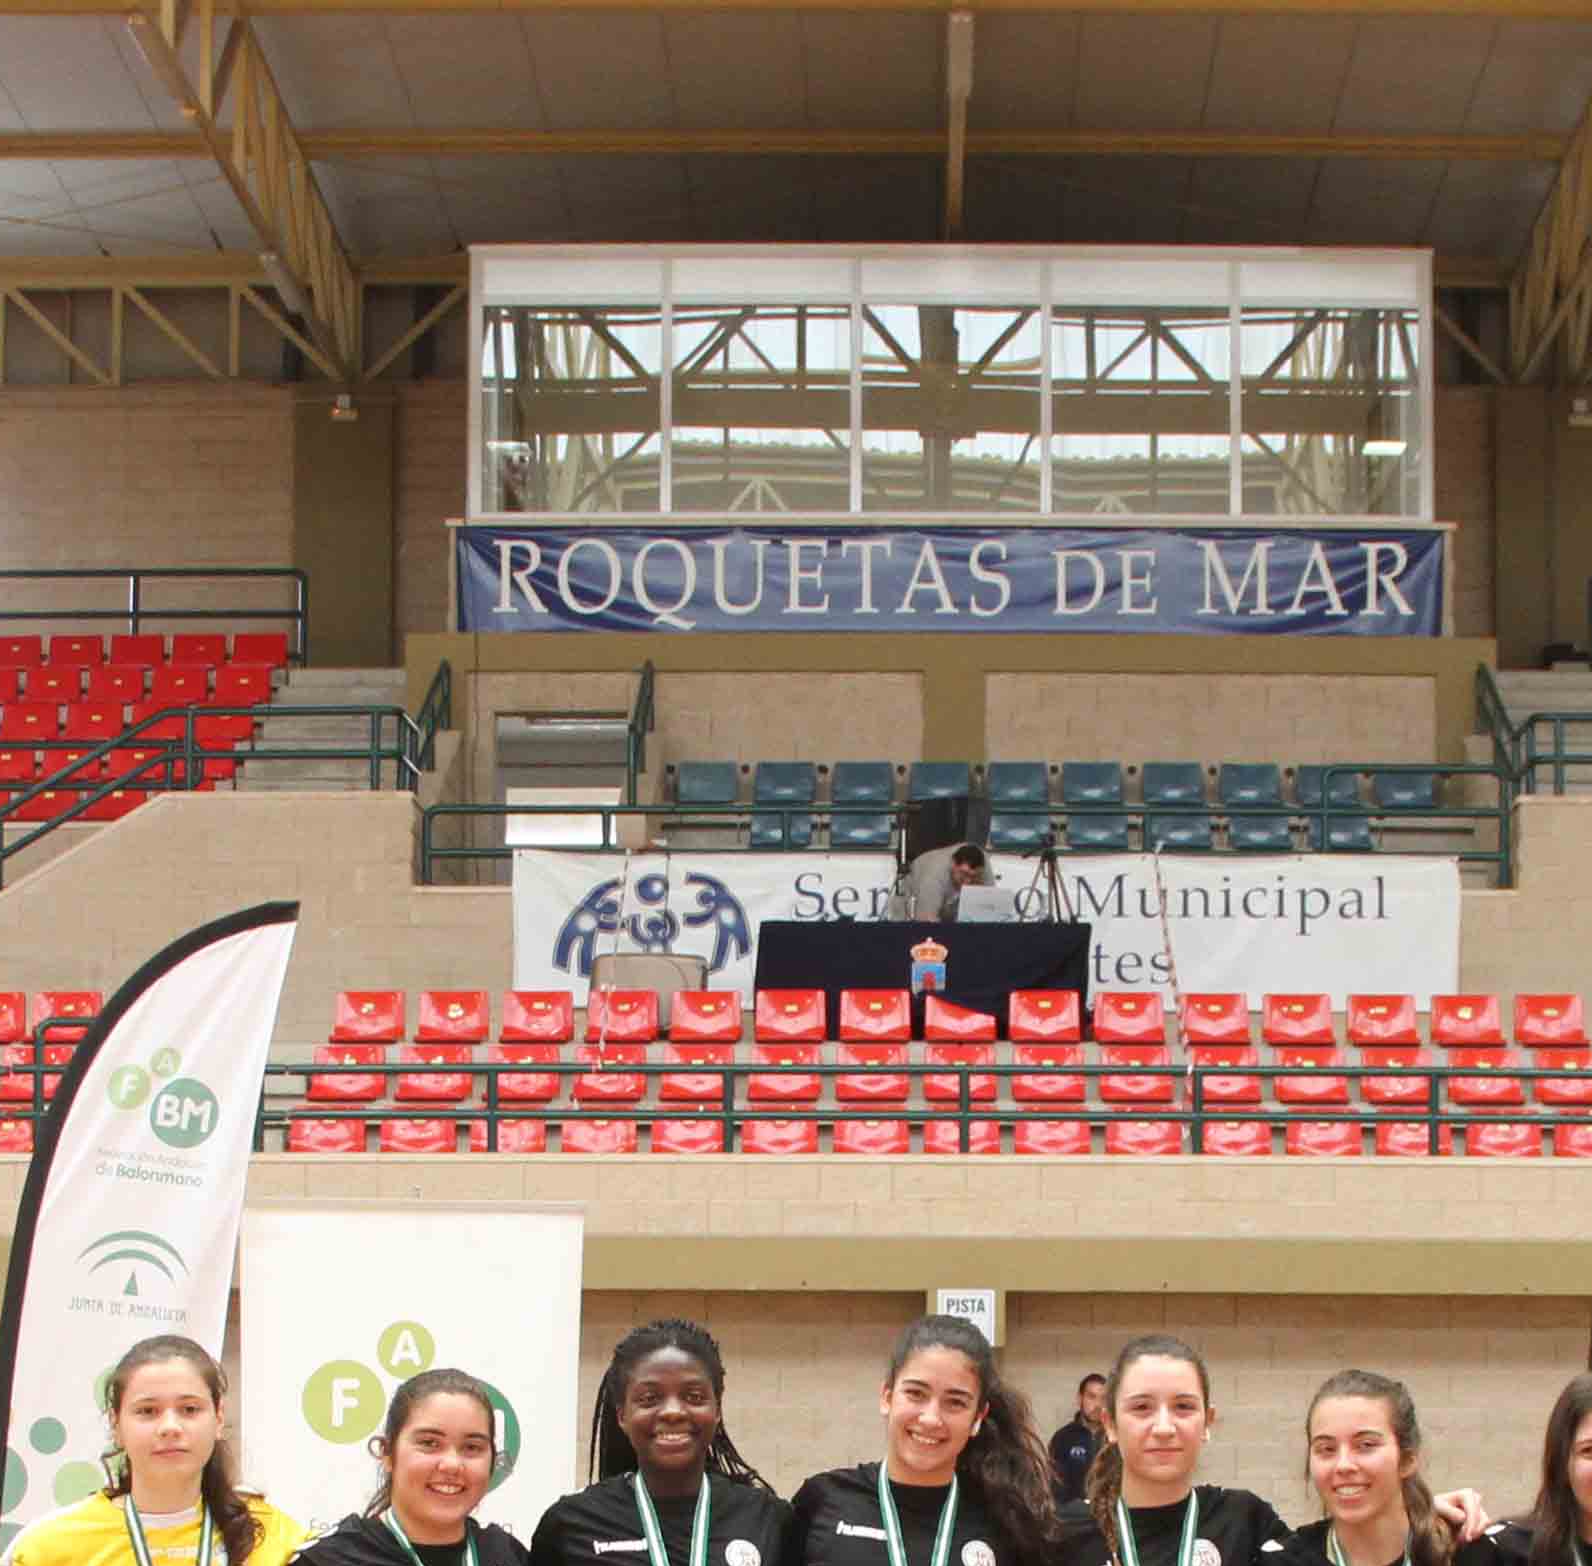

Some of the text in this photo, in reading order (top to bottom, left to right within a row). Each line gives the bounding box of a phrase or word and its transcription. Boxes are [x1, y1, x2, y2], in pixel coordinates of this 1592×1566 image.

[492, 538, 1415, 629] ROQUETAS DE MAR
[1074, 873, 1392, 936] Municipal
[946, 1299, 985, 1313] PISTA
